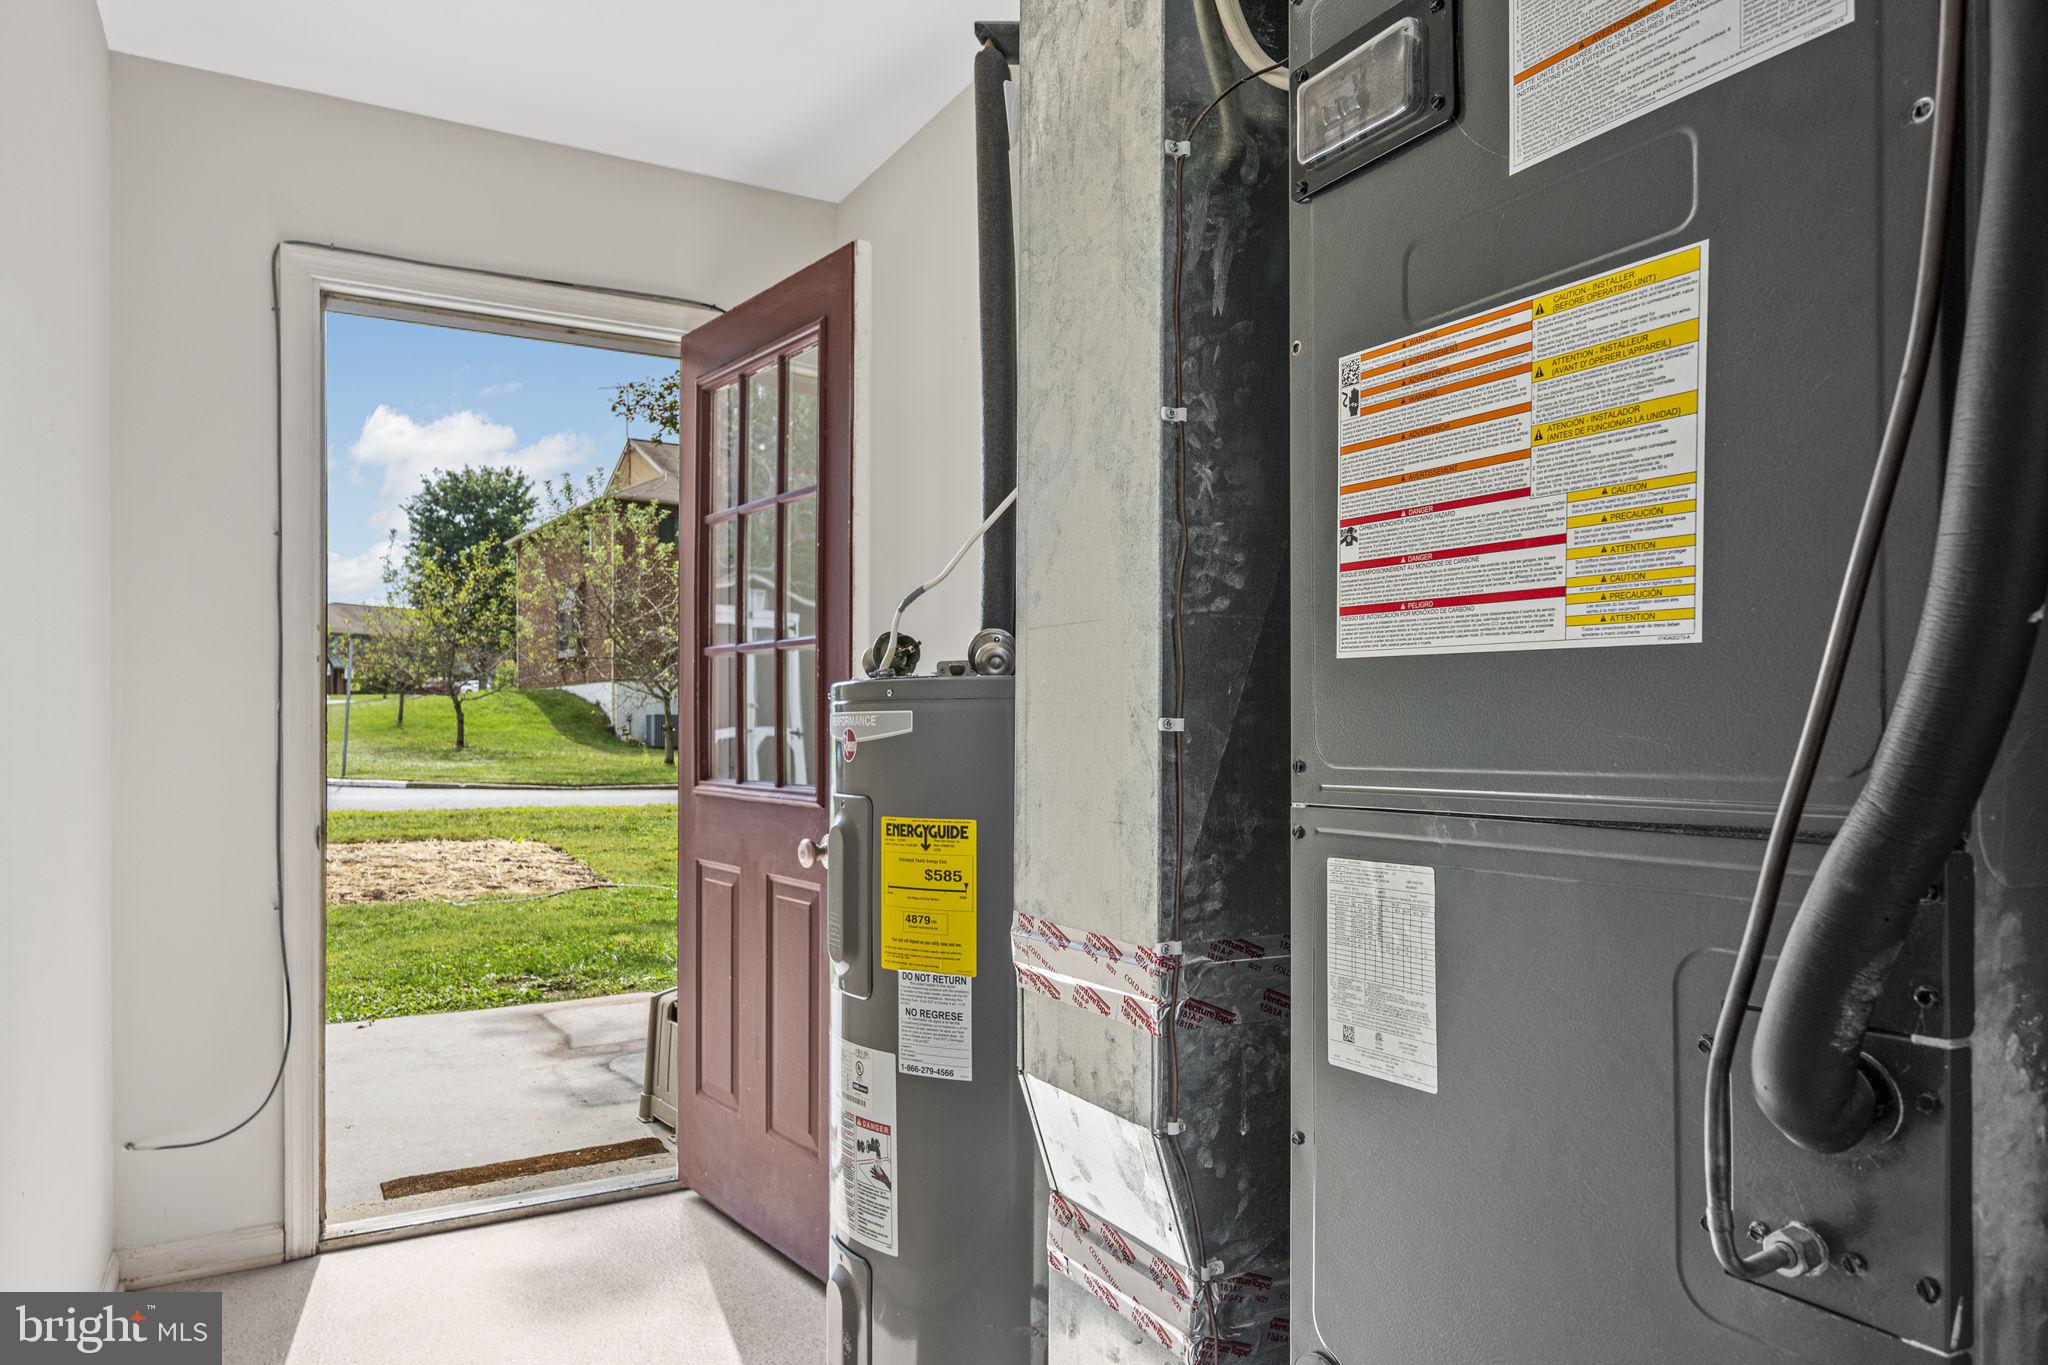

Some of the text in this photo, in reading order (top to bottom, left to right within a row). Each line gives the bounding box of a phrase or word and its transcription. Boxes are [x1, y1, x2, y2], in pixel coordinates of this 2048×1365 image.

[1556, 59, 1568, 70] EST
[1594, 36, 1613, 50] AVEC
[1614, 30, 1626, 40] 150
[1633, 20, 1645, 31] 200
[1562, 61, 1580, 74] POUR
[1606, 40, 1621, 54] DES
[1622, 20, 1664, 46] BLESSURES
[1552, 272, 1656, 312] (BEFORE OPERATING UNIT)
[1553, 286, 1586, 303] CAUTION
[1592, 270, 1634, 290] INSTALLER
[1408, 330, 1437, 346] WARNING
[1408, 344, 1458, 365] AVERTISSEMENT
[1552, 348, 1593, 366] ATTENTION
[1600, 333, 1648, 353] INSTALLEUR
[1552, 361, 1578, 376] (AVANT
[1589, 350, 1620, 366] OPERER
[1622, 337, 1671, 358] L'APPAREIL)
[1408, 366, 1450, 384] ADVERTENCIA
[1408, 389, 1438, 403] WARNING
[1546, 406, 1681, 442] (ANTES DE FUNCIONAR LA UNIDAD)
[1547, 416, 1584, 432] ATENCIÓN
[1590, 405, 1640, 422] INSTALADOR
[1408, 422, 1450, 438] ADVERTENCIA
[1408, 463, 1456, 480] AVERTISSEMENT
[1611, 481, 1647, 494] CAUTION
[1408, 505, 1433, 515] DANGER
[1610, 506, 1663, 520] PRECAUCIÓN
[1358, 510, 1455, 531] CARBON MONOXIDE POISONING HAZARD
[1610, 540, 1655, 552] ATTENTION
[1407, 553, 1432, 562] DANGER
[1415, 560, 1444, 569] MONOXYDE
[1453, 555, 1479, 564] CARBONE
[1609, 572, 1645, 582] CAUTION
[1609, 588, 1662, 599] PRECAUCIÓN
[1407, 600, 1433, 609] PELIGRO
[1448, 605, 1474, 613] CARBONO
[1609, 612, 1655, 622] ATTENTION
[886, 822, 969, 840] ENERGYGUIDE
[924, 868, 962, 882] $585
[905, 914, 931, 925] 4879
[902, 972, 967, 985] DO NOT RETURN
[1124, 973, 1140, 992] COLD
[905, 1007, 963, 1021] NO REGRESE
[901, 1064, 954, 1077] 1-866-279-4566
[862, 1120, 889, 1134] DANGER
